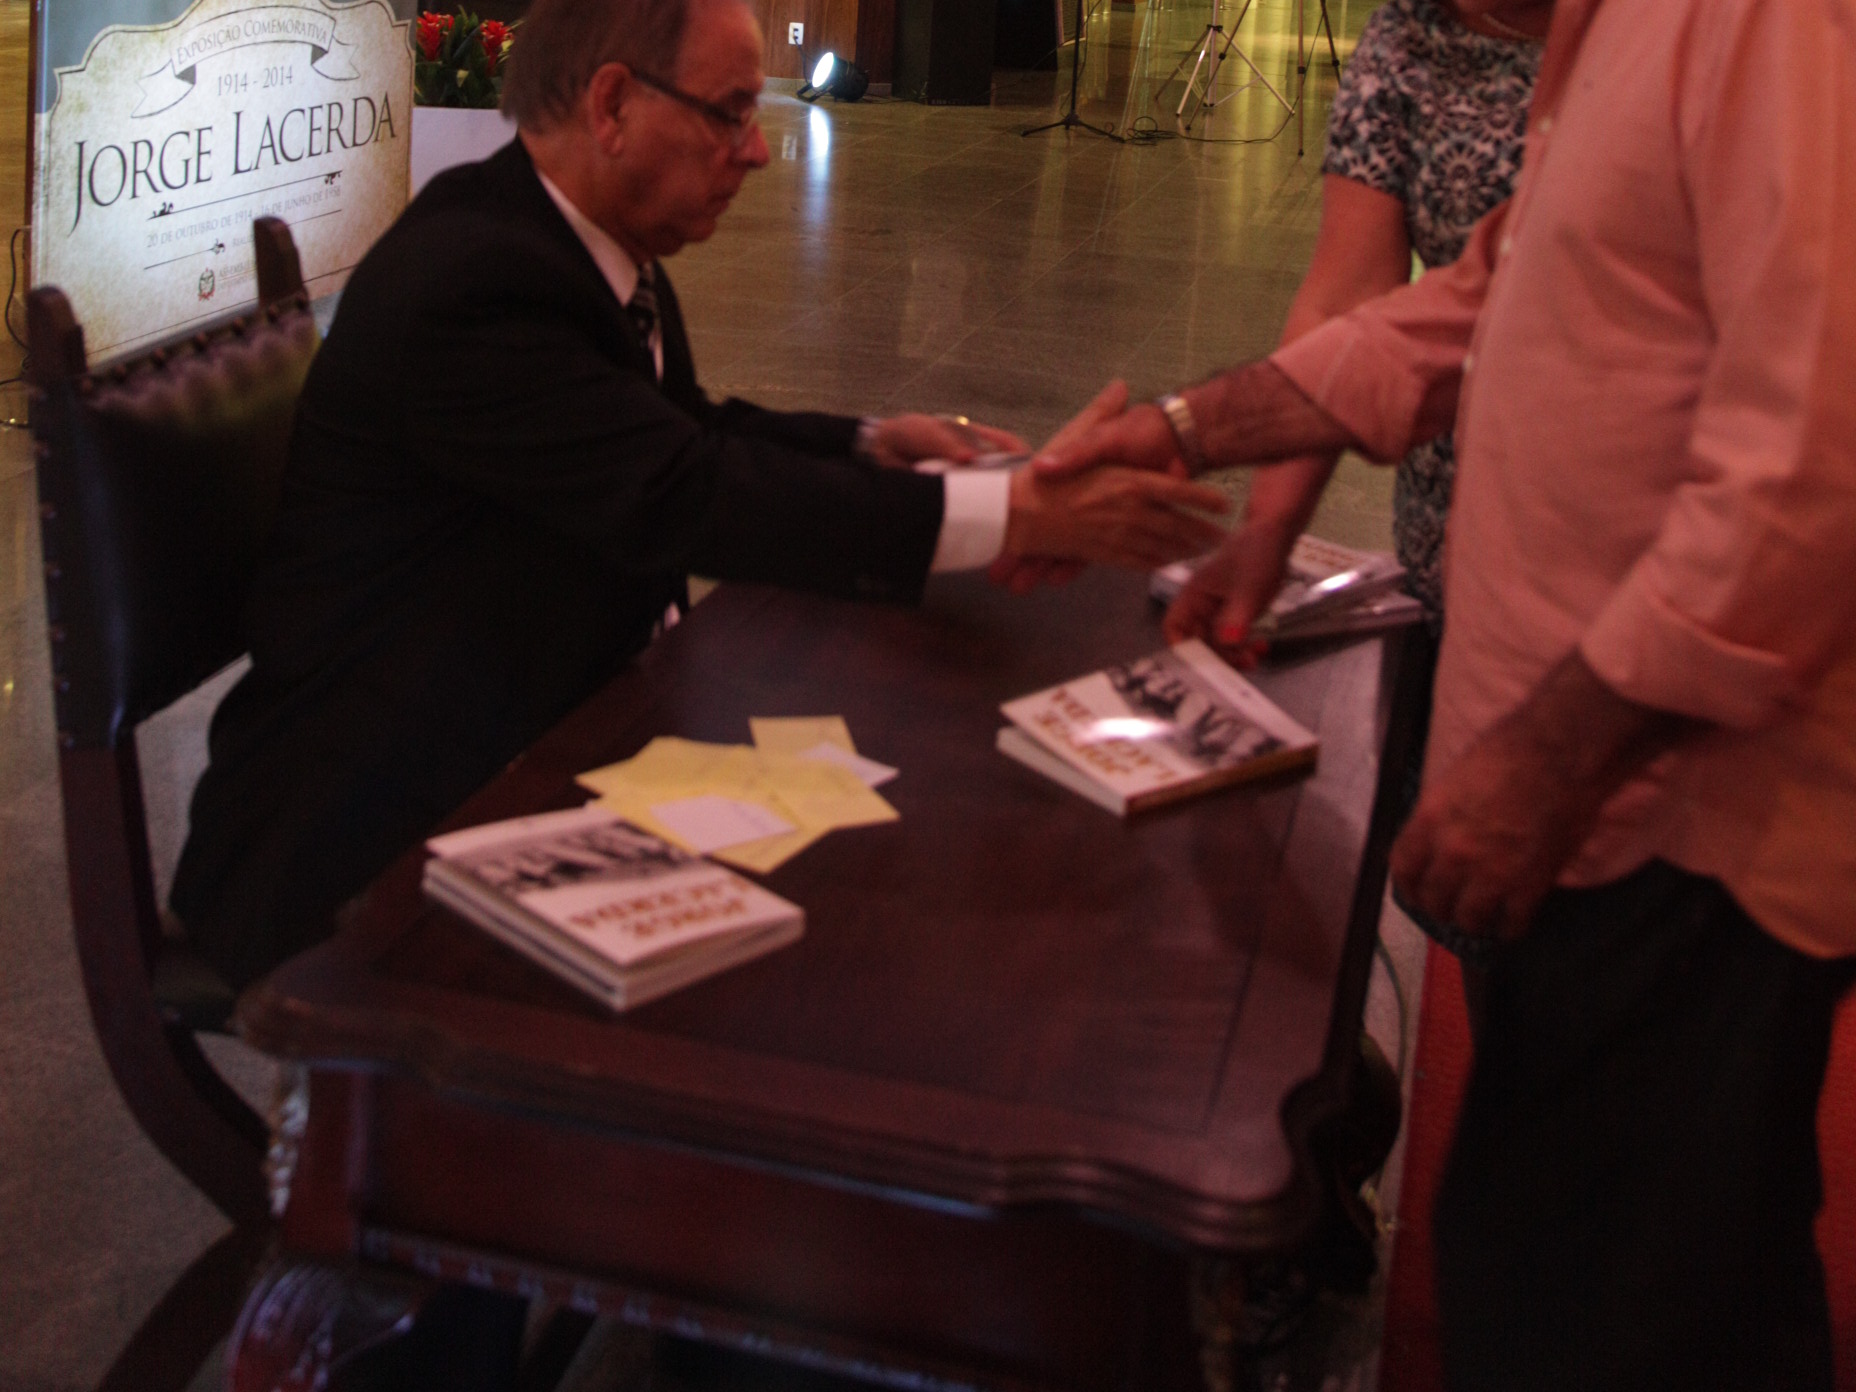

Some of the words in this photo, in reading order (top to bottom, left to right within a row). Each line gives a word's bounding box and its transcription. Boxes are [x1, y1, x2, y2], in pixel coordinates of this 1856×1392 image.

[217, 71, 248, 96] 1914
[262, 64, 293, 89] 2014
[67, 126, 213, 238] JORGE
[231, 91, 397, 175] LACERDA
[161, 230, 174, 244] DE
[175, 219, 219, 240] OUTUBRO
[220, 214, 232, 228] DE
[234, 209, 253, 225] 1914
[283, 194, 311, 214] JUNHO
